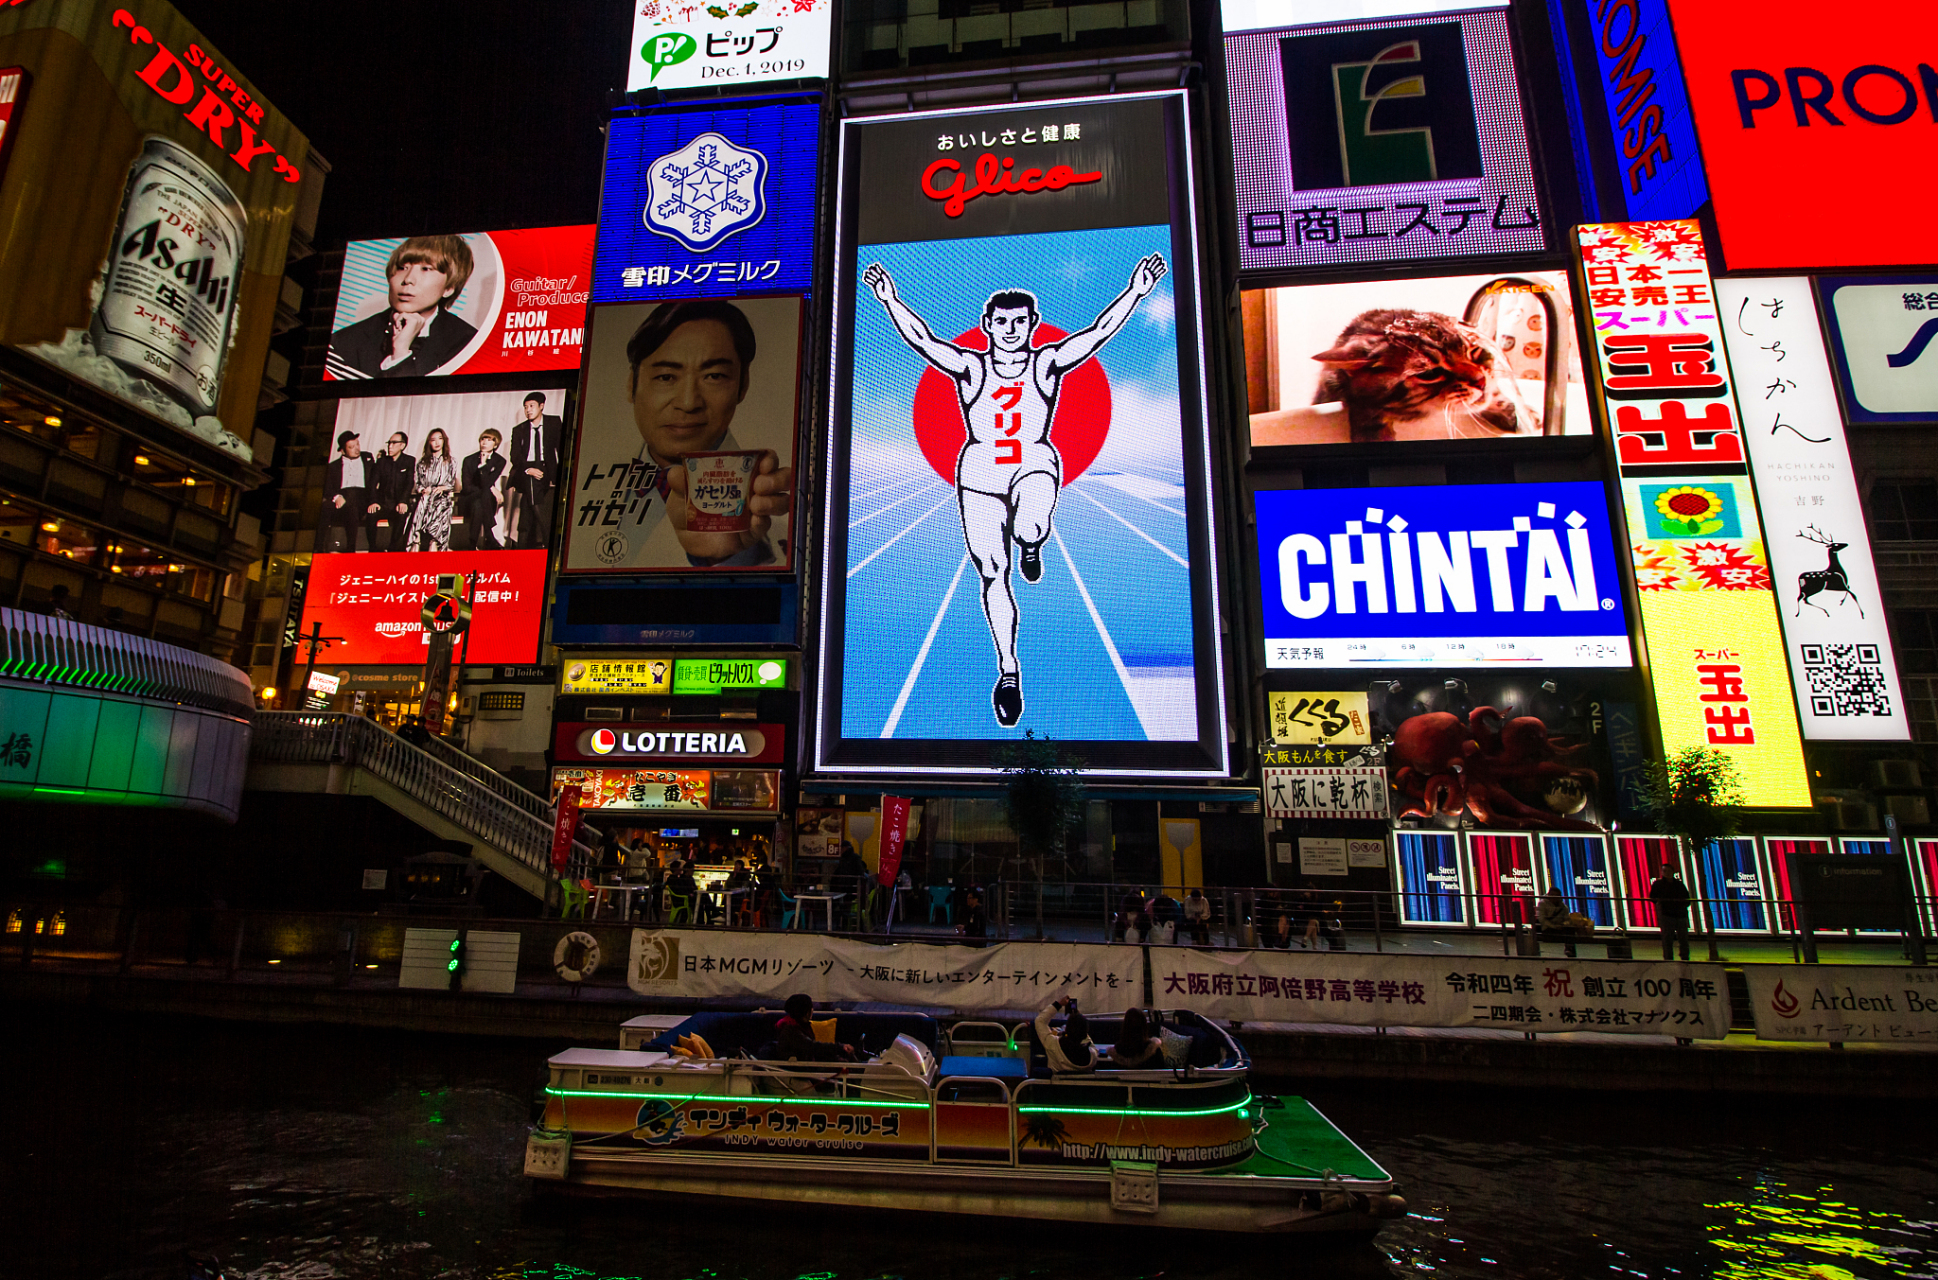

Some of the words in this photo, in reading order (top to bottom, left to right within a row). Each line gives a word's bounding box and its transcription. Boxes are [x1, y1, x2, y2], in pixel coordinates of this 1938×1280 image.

[706, 26, 783, 57] ピップ
[701, 65, 740, 79] Dec.
[760, 59, 805, 74] 2019
[184, 44, 264, 125] SUPER
[1730, 63, 1938, 129] PRO
[937, 123, 1081, 151] おいしさと健康
[157, 190, 171, 201] THE
[921, 153, 1102, 217] Glico
[1247, 195, 1540, 248] 日商エステム
[122, 220, 229, 314] Asahi
[621, 260, 780, 287] 雪印メグミルク
[1587, 264, 1703, 285] 日本一
[510, 275, 577, 292] Guitar/
[156, 284, 187, 317] 生
[1590, 284, 1710, 308] 安売王
[134, 305, 197, 349] スーパードライ
[505, 310, 548, 329] ENON
[1594, 308, 1715, 330] スーパー
[144, 350, 172, 374] 350ml
[1603, 333, 1748, 477] 玉出
[991, 381, 1025, 465] グリコ
[582, 463, 658, 490] トクホ
[610, 490, 623, 498] の
[577, 498, 653, 526] ガセリ
[702, 501, 733, 510] ヨーグルト
[1695, 549, 1753, 585] 激安
[283, 578, 304, 648] TSUTAYA
[375, 622, 421, 633] amazon
[640, 629, 695, 638] 雪印メグミルク
[1277, 647, 1324, 661] 天気予報
[1694, 648, 1739, 660] スーパー
[392, 673, 418, 682] store
[517, 668, 544, 677] Toilets
[590, 664, 646, 674] 店舗情報館
[709, 663, 754, 683] ピタットハウス
[1697, 665, 1755, 745] 玉出
[1288, 698, 1350, 737] くくる
[622, 732, 746, 753] LOTTERIA
[1264, 749, 1348, 764] 大阪もんを食す
[1367, 757, 1381, 766] 2F
[634, 771, 678, 782] たこやき
[593, 770, 603, 807] TAKOYAKI
[1271, 776, 1369, 810] 大阪に乾杯
[1427, 874, 1458, 882] Illuminated
[1439, 866, 1456, 874] Street
[1501, 875, 1531, 884] Illuminated
[1513, 868, 1529, 876] Street
[1587, 870, 1604, 878] Street
[1738, 872, 1755, 880] Street
[1575, 877, 1606, 885] Illuminated
[1726, 880, 1758, 888] Illuminated
[684, 956, 834, 976] 日本MGMリゾーツ
[860, 964, 1119, 988] 大阪に新しいエンターテインメントを
[1163, 972, 1426, 1005] 大阪府立阿倍野高等学校
[1446, 972, 1534, 995] 令和四年
[1542, 968, 1574, 998] 祝
[1811, 987, 1897, 1012] Ardent
[1473, 1004, 1704, 1026] 二四期会・株式会社マナックス
[1813, 1024, 1880, 1036] アーデント
[1890, 1025, 1938, 1038] ビュー
[688, 1106, 762, 1132] インディ
[768, 1111, 900, 1137] ウォータークルーズ
[725, 1134, 758, 1145] INDY
[768, 1137, 808, 1148] water
[817, 1138, 864, 1149] cruise
